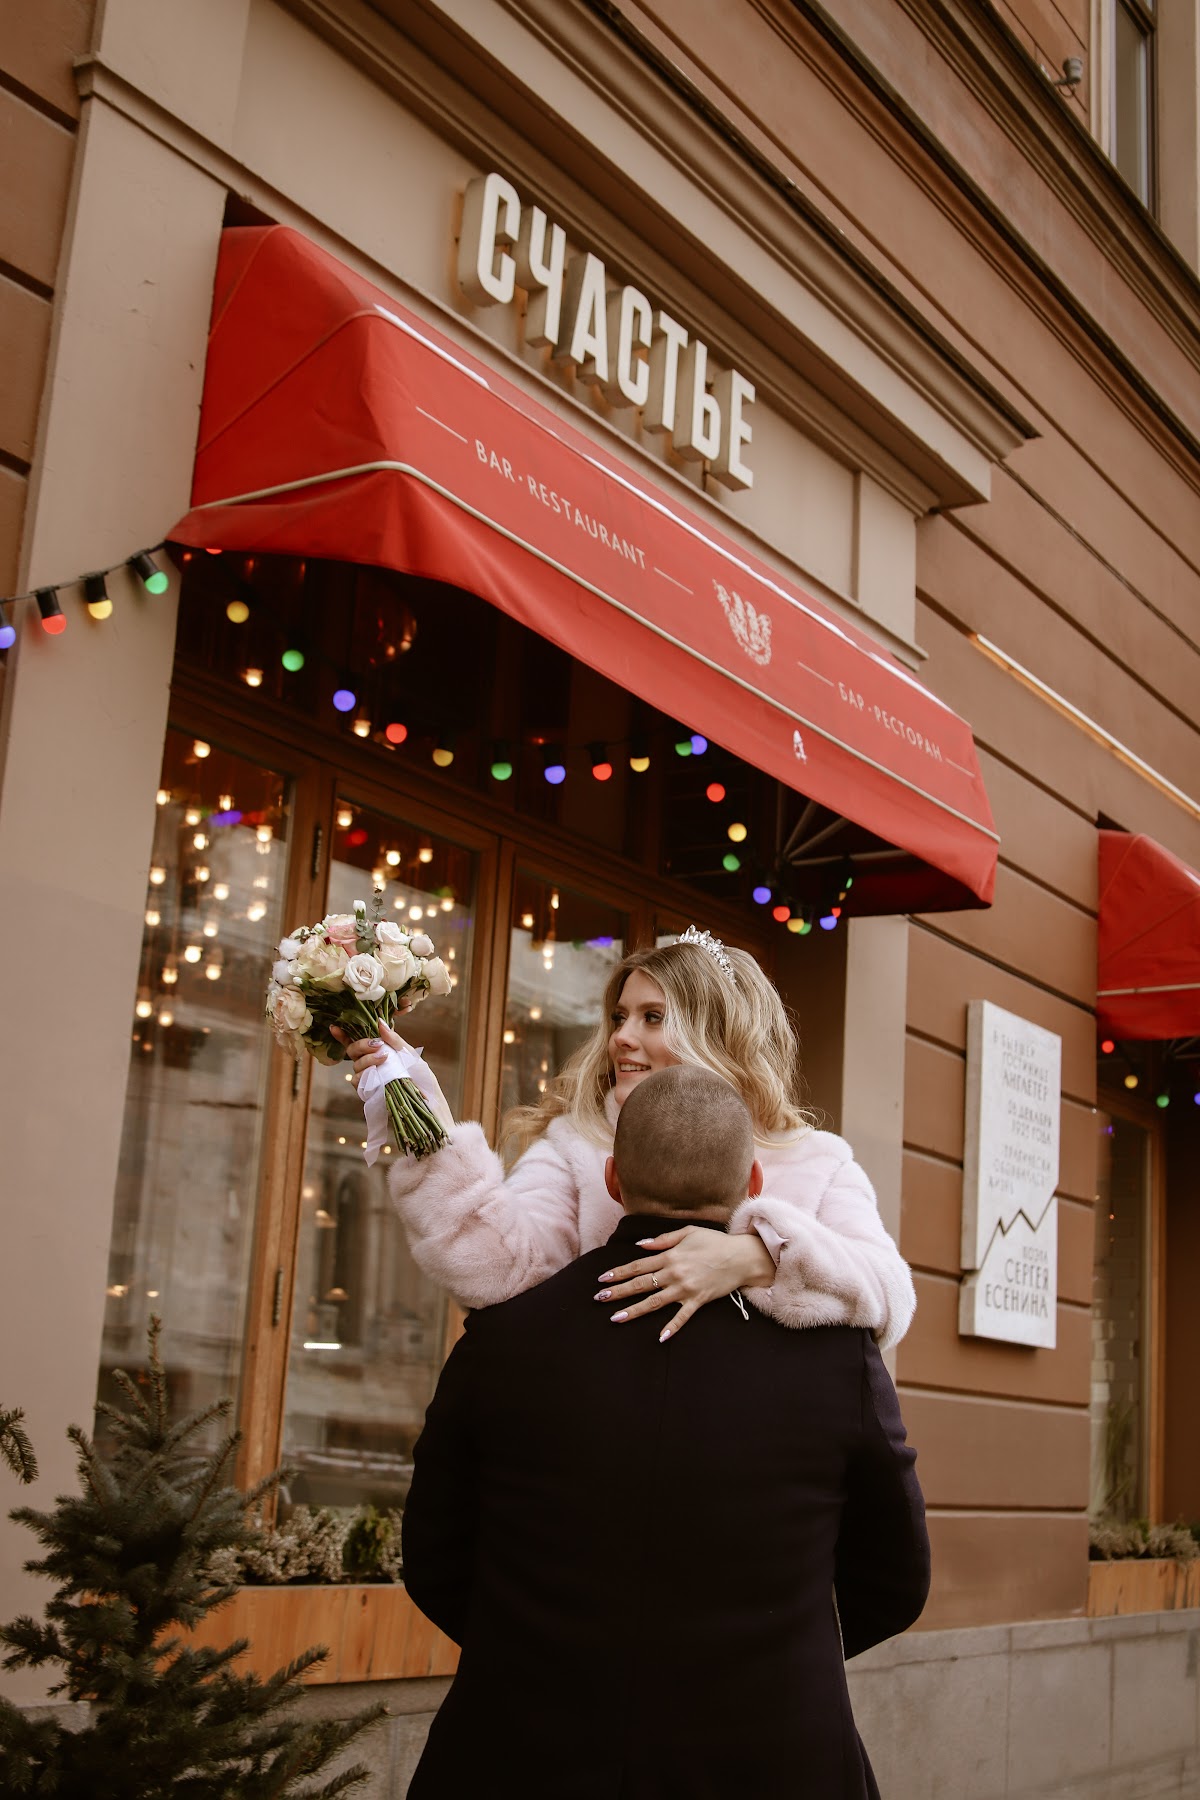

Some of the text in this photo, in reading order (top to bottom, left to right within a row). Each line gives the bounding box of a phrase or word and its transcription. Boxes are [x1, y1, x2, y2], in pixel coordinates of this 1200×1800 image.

[475, 171, 756, 490] СЧАСТЬЕ
[1001, 1069, 1048, 1102] АНГЛЕТЕР
[1004, 1257, 1049, 1292] СЕРГЕЯ
[984, 1282, 1049, 1320] ЕСЕНИНА
